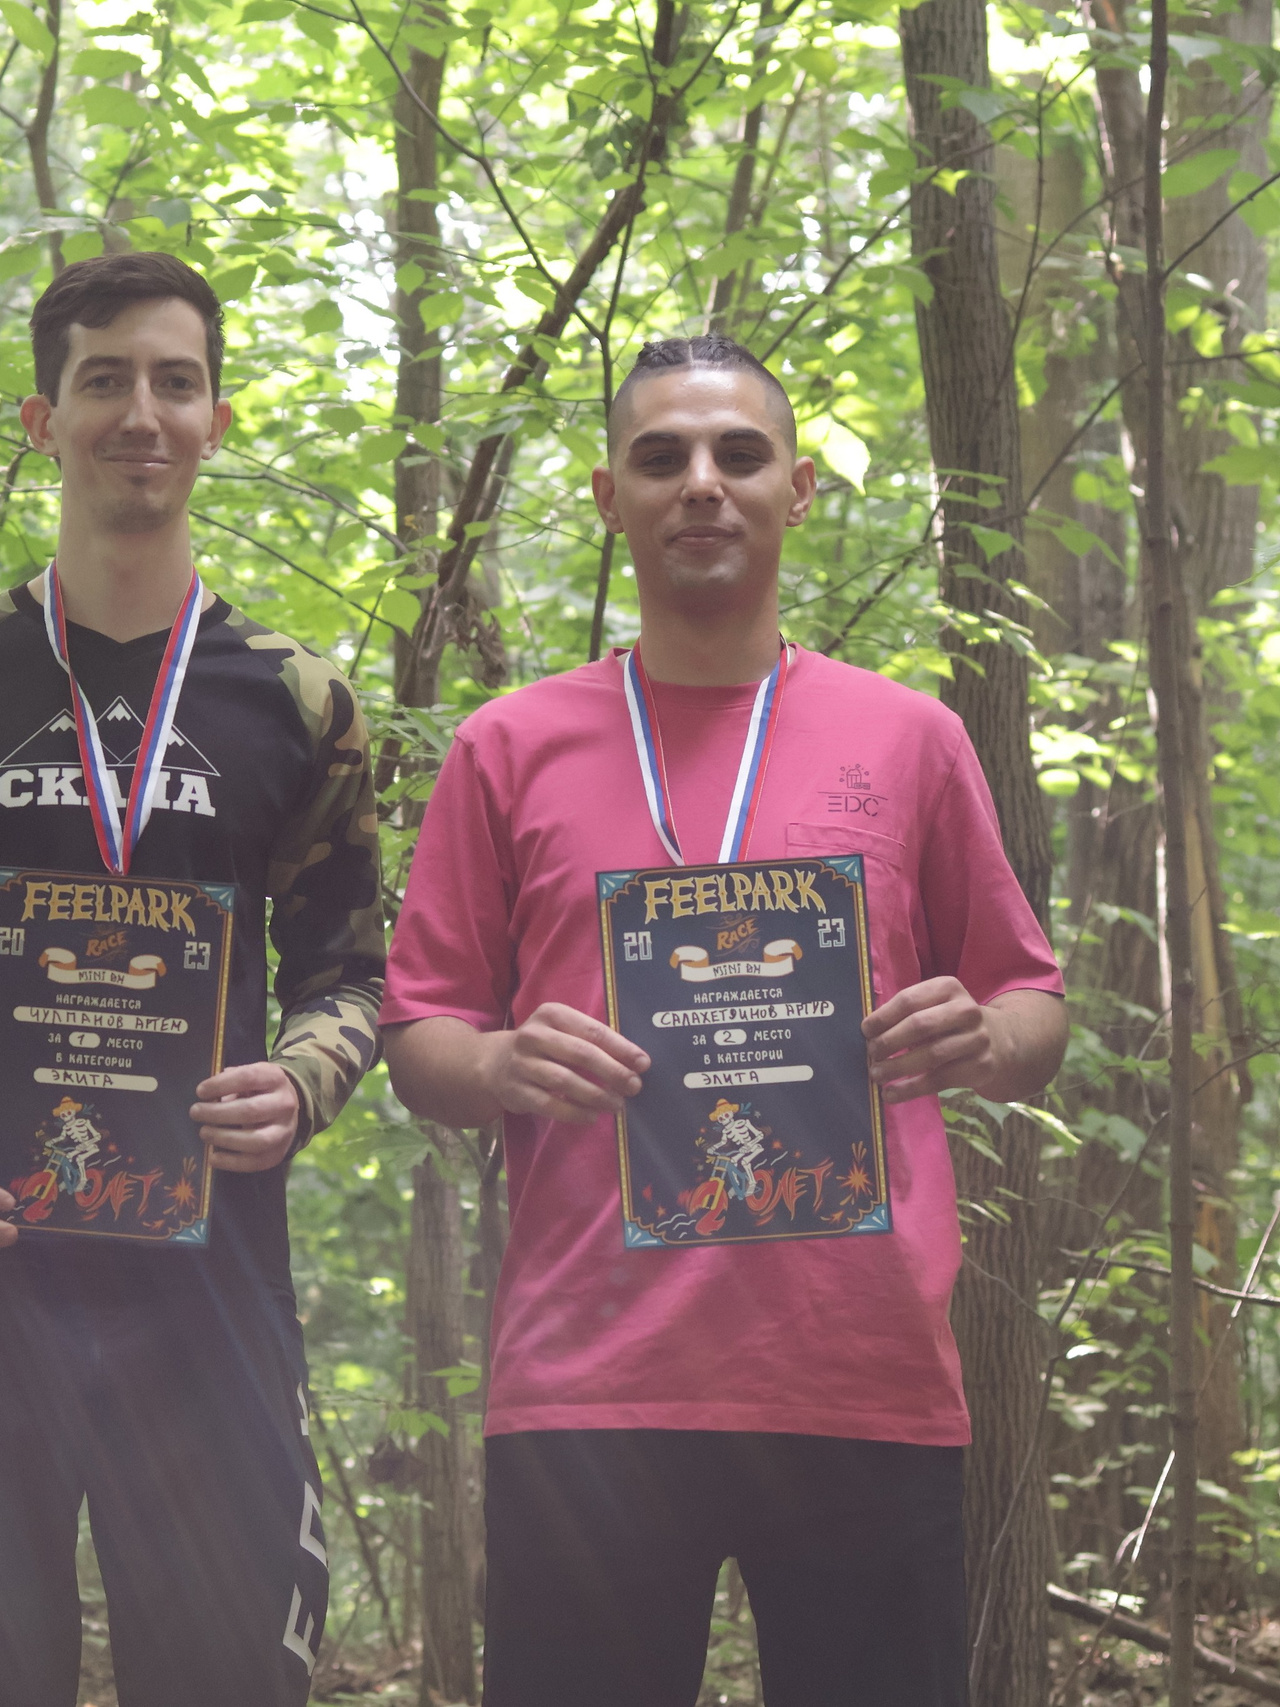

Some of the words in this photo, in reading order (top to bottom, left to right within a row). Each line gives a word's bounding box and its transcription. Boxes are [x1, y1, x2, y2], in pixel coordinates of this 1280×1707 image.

[828, 796, 879, 817] EDC
[644, 868, 827, 925] FEELPARK
[21, 881, 196, 937] FEELPARK
[716, 918, 760, 951] RACE
[817, 917, 846, 948] 23
[85, 930, 128, 957] RACE
[623, 930, 653, 961] 20
[184, 941, 212, 971] 23
[78, 970, 106, 982] MINI
[712, 963, 741, 977] MINI
[56, 994, 142, 1010] НАГРАЖДАЕТСЯ
[693, 987, 783, 1004] НАГРАЖДАЕТСЯ
[135, 1017, 183, 1032] АРТЕМ
[48, 1032, 62, 1044] ЗА
[77, 1033, 86, 1046] 1
[106, 1037, 144, 1050] МЕСТО
[692, 1034, 707, 1046] ЗА
[722, 1030, 737, 1044] 2
[753, 1028, 793, 1042] МЕСТО
[55, 1052, 63, 1063] В
[69, 1053, 133, 1069] КАТЕГОРИИ
[703, 1053, 711, 1066] В
[717, 1049, 784, 1065] КАТЕГОРИИ
